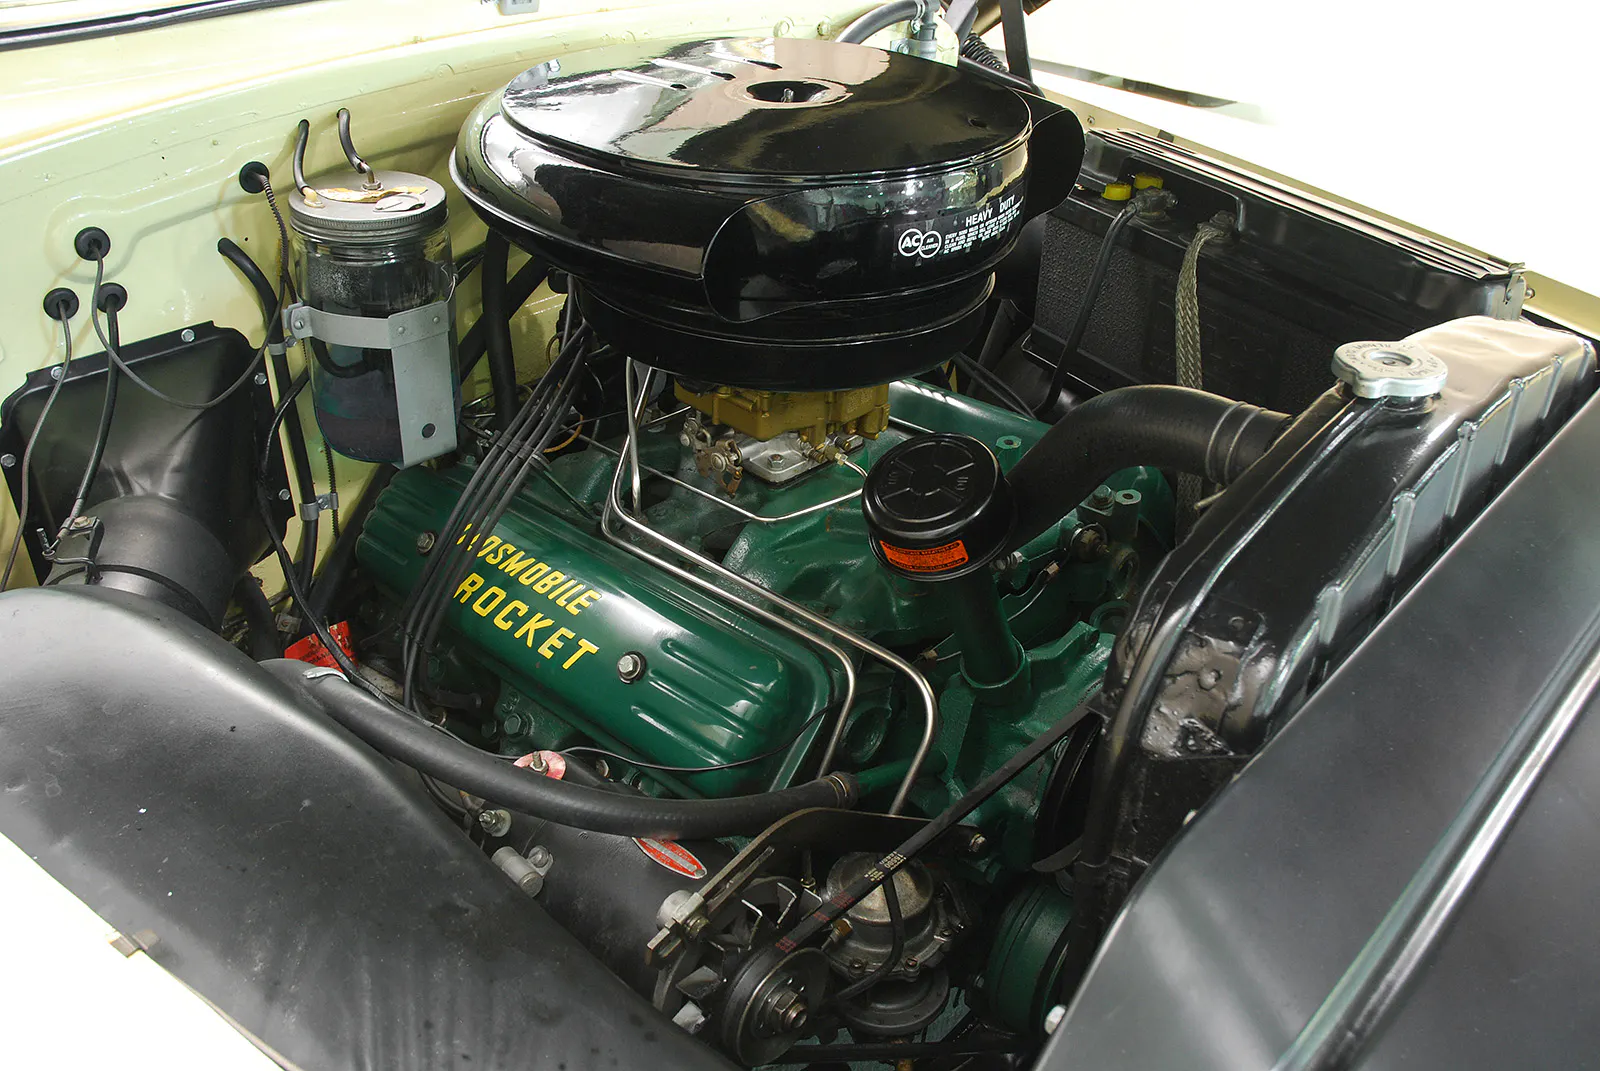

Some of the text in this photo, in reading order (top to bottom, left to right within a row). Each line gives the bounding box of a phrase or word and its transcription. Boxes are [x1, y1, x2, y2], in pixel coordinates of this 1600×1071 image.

[901, 234, 920, 249] AC
[965, 208, 994, 227] HEAVY
[999, 194, 1015, 213] DUTY
[456, 523, 603, 616] DSMOBILE
[453, 572, 600, 671] ROCKET
